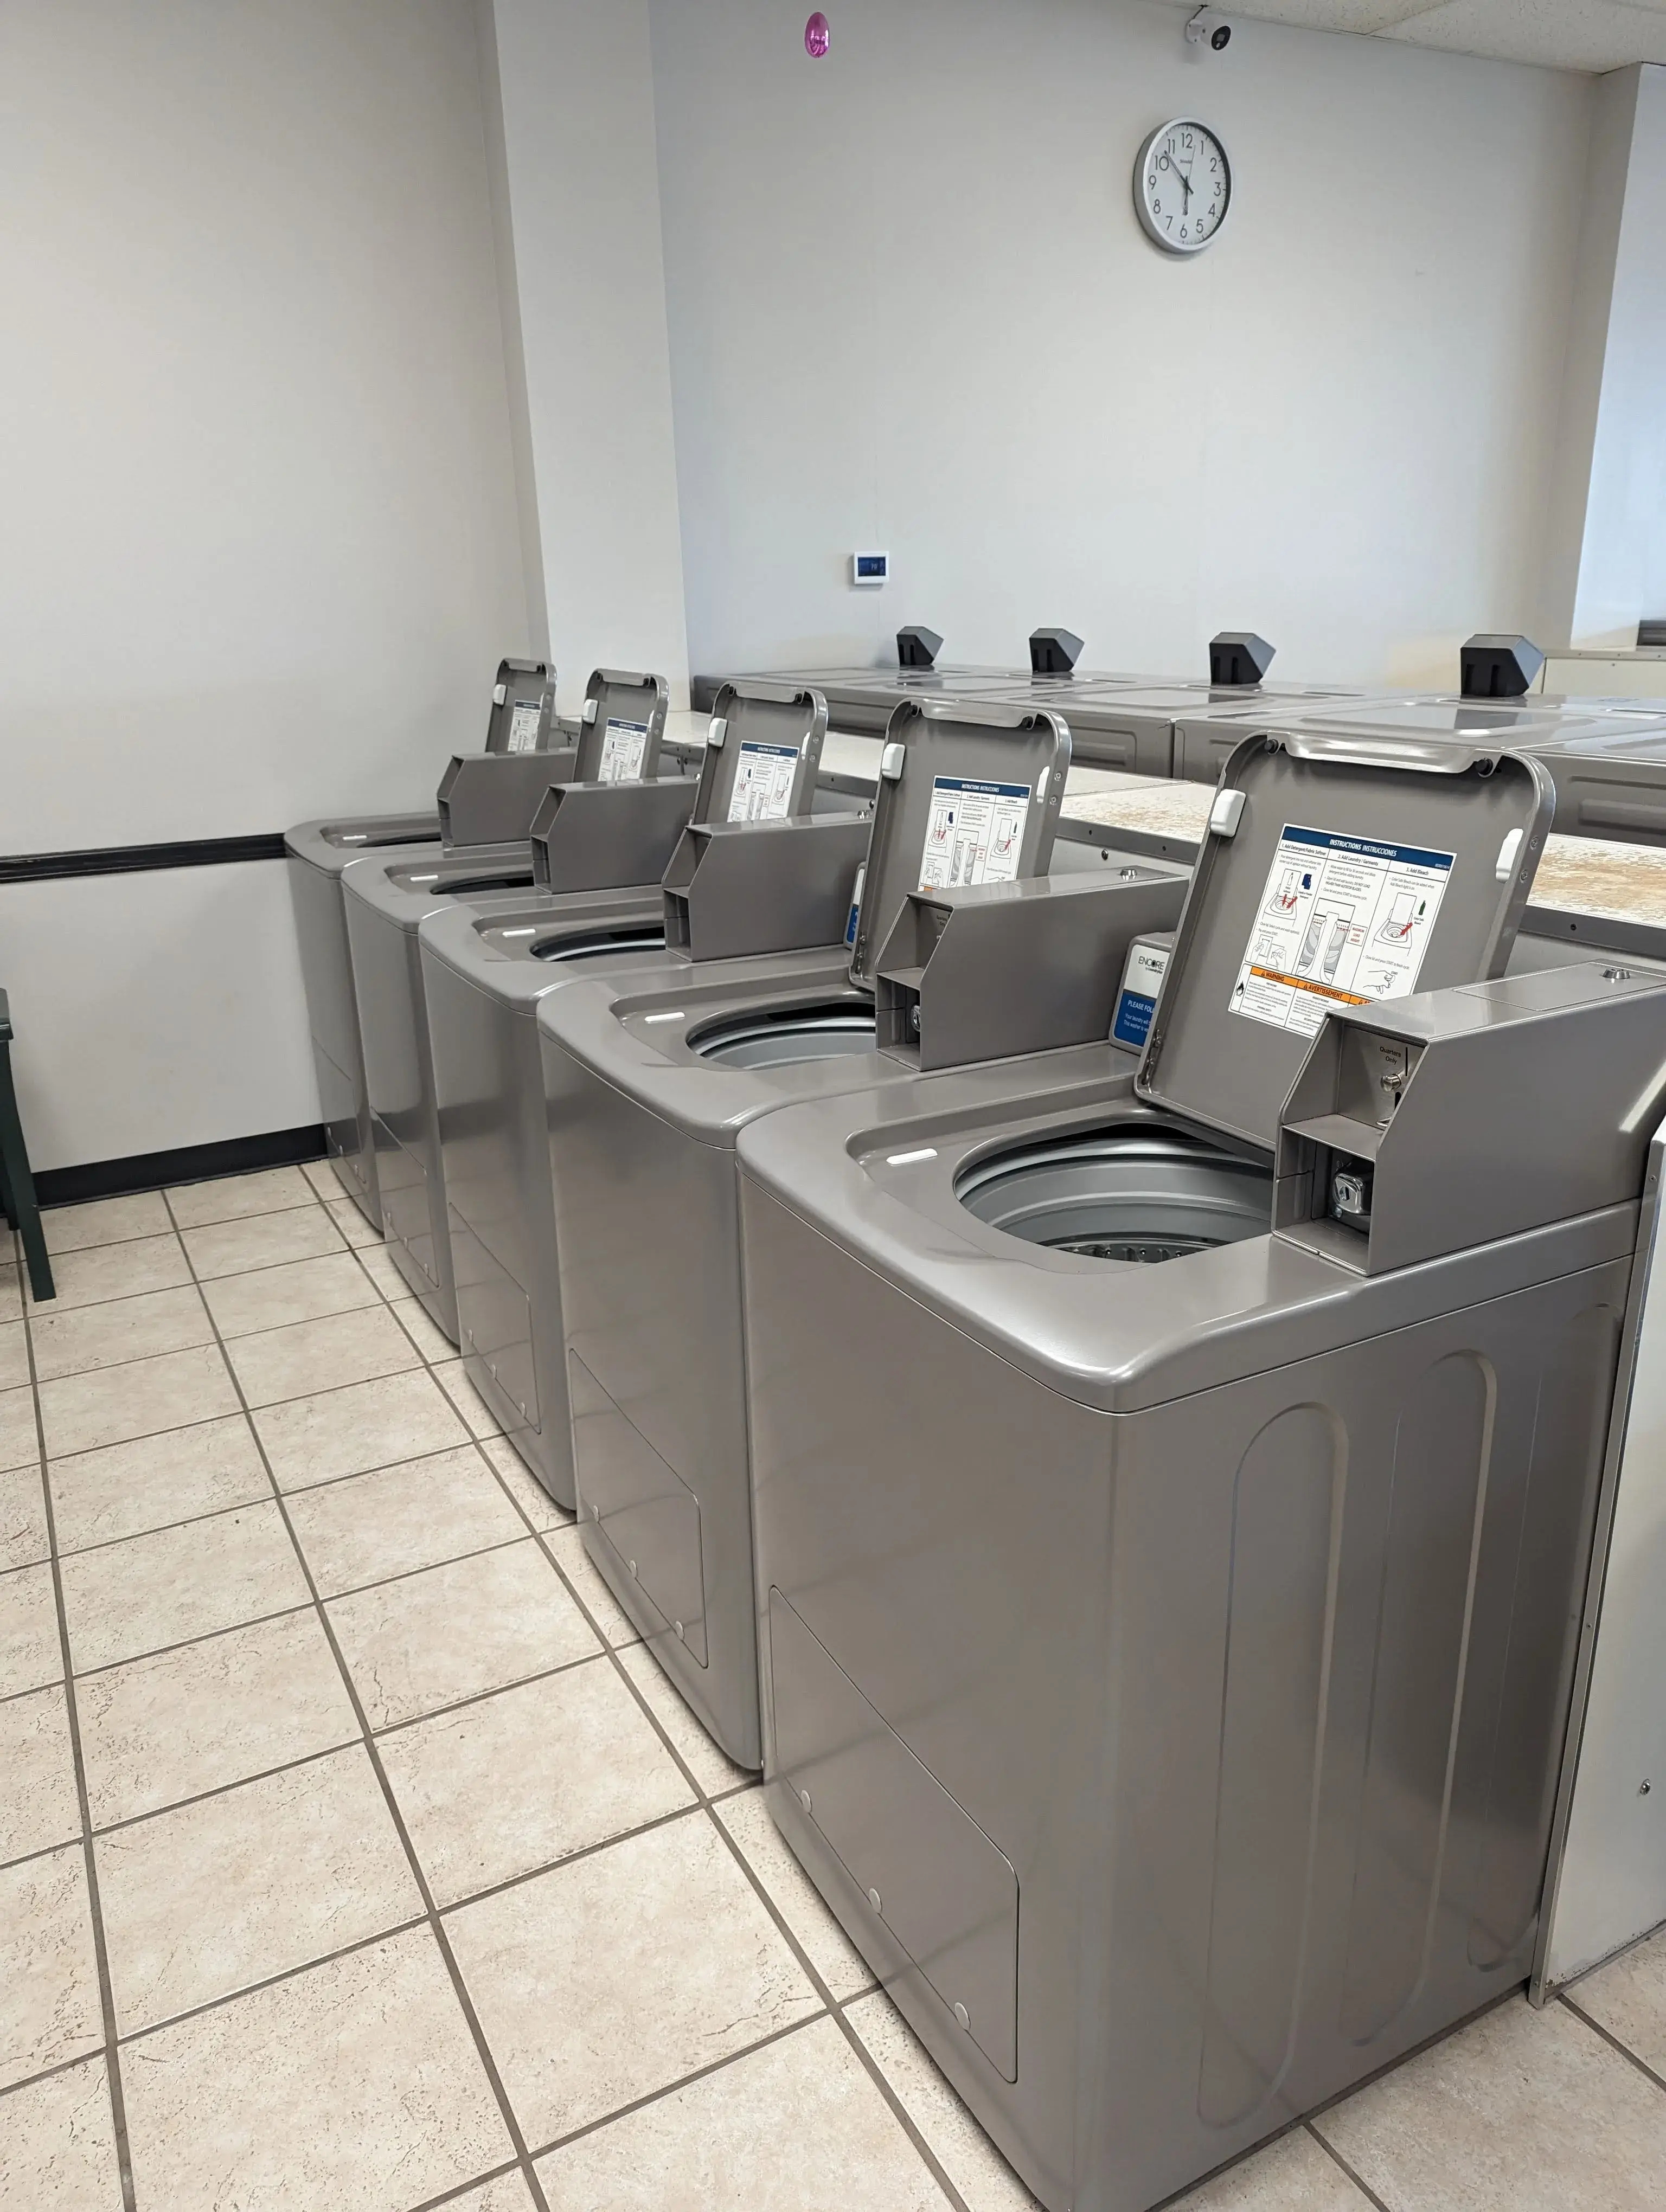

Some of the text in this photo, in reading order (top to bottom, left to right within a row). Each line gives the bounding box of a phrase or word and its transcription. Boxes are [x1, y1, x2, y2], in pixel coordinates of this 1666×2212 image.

[1168, 139, 1175, 154] 11
[1181, 133, 1193, 149] 12
[1201, 140, 1204, 155] 1
[1155, 156, 1169, 171] 10
[1210, 157, 1217, 172] 2
[1149, 175, 1156, 190] 9
[1214, 182, 1221, 196] 3
[1154, 199, 1161, 214] 8
[1208, 203, 1215, 217] 4
[1166, 216, 1173, 230] 7
[1180, 223, 1187, 238] 6
[1196, 219, 1203, 233] 5
[1329, 839, 1397, 857] INSTRUCTIONS INSTRUCCIONES
[1138, 956, 1165, 970] ENCORE
[1266, 972, 1284, 981] WARNING
[1308, 984, 1343, 999] AVERTISSEMENT
[1127, 1000, 1144, 1011] PLEASE
[1380, 1046, 1401, 1057] Quarters
[1385, 1056, 1397, 1065] Only
